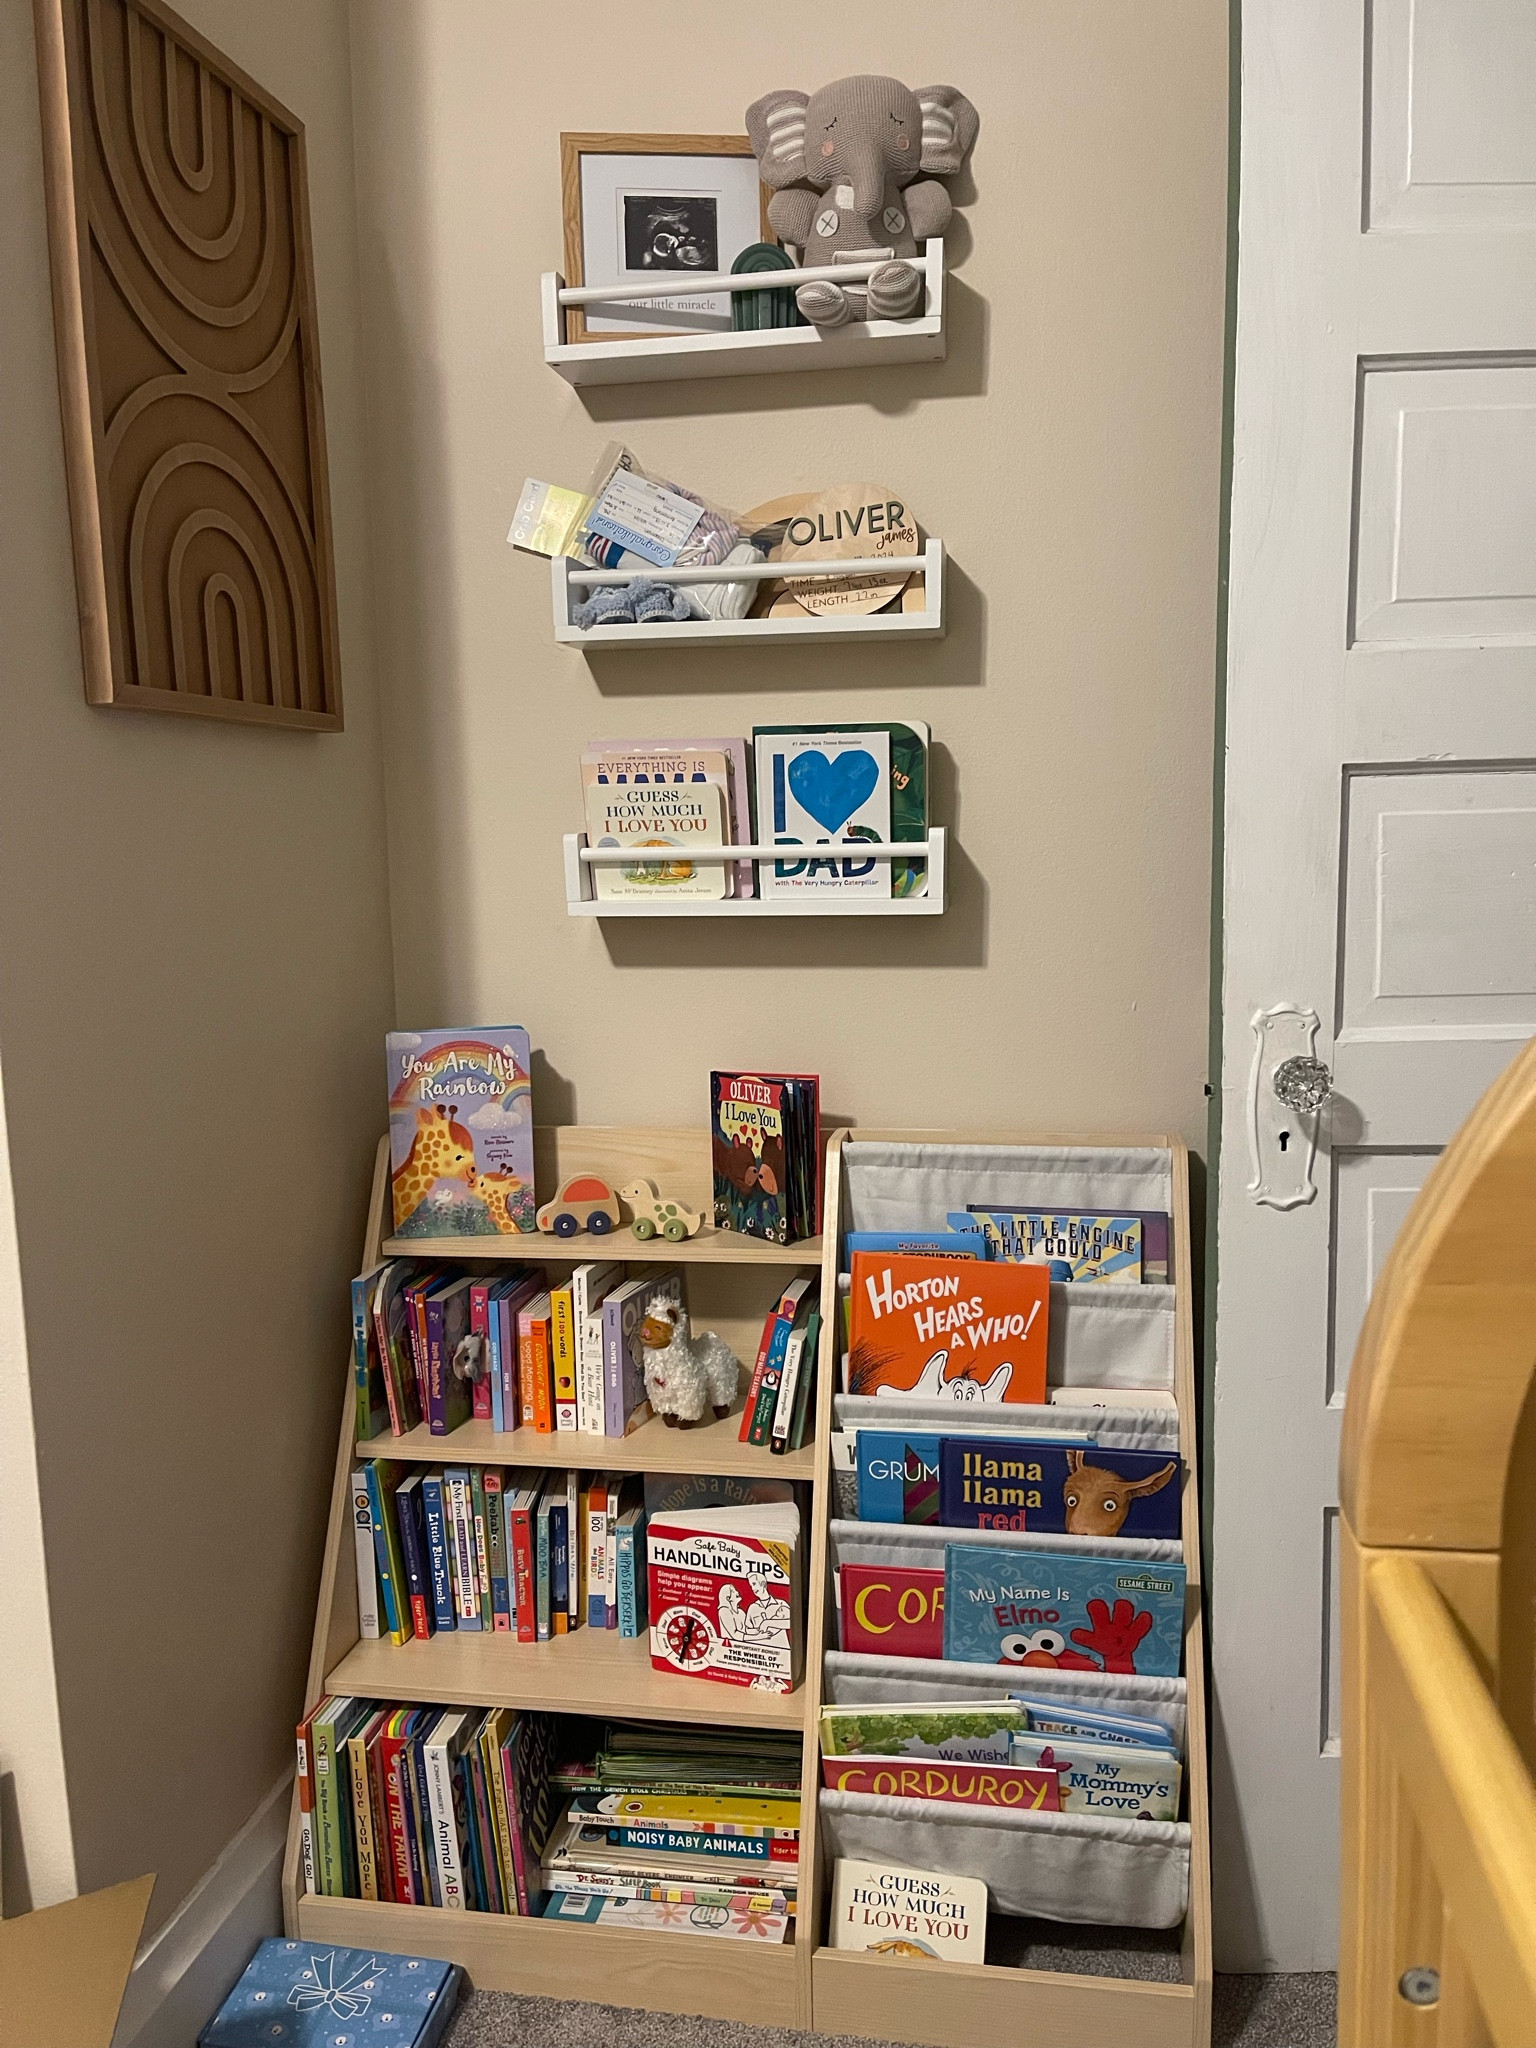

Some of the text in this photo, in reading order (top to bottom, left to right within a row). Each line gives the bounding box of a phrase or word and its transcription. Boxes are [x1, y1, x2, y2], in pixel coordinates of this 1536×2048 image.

[651, 299, 674, 309] little
[677, 299, 715, 309] miracle
[788, 501, 904, 545] OLIVER
[876, 528, 915, 549] james
[790, 577, 815, 586] TIME
[797, 585, 838, 598] WEIGHT
[807, 595, 848, 608] LENGTH
[598, 762, 705, 773] EVERYTHING IS
[627, 791, 679, 803] GUESS
[607, 805, 702, 817] HOW MUCH
[605, 819, 707, 833] I LOVE YOU
[774, 838, 876, 878] DAD
[402, 1052, 516, 1080] You Are My
[418, 1077, 507, 1100] Rainbow
[730, 1082, 771, 1104] OLIVER
[725, 1103, 776, 1128] I Love You
[1000, 1219, 1059, 1239] LITTLE
[1069, 1223, 1136, 1253] ENGINE
[991, 1237, 1102, 1261] THAT COULD
[865, 1268, 960, 1319] HORTON
[558, 1301, 566, 1318] first
[913, 1296, 983, 1342] HEARS
[951, 1300, 1042, 1350] A WHO!
[559, 1336, 567, 1358] words
[535, 1343, 544, 1386] GOODNIGHT
[505, 1383, 509, 1391] ME
[587, 1373, 595, 1407] Bear Hunt
[963, 1453, 1043, 1482] llama
[452, 1487, 461, 1500] My
[660, 1483, 692, 1512] Hope
[963, 1480, 1043, 1509] llama
[354, 1488, 372, 1534] roar
[455, 1501, 463, 1518] First
[977, 1509, 1027, 1532] red
[428, 1512, 440, 1543] Little
[457, 1520, 465, 1540] READ
[591, 1516, 601, 1532] 100
[432, 1546, 443, 1569] Blue
[694, 1539, 741, 1558] Safe Baby
[460, 1553, 468, 1576] LEARN
[654, 1546, 742, 1573] HANDLING
[745, 1560, 785, 1579] TIPS
[435, 1569, 445, 1605] Truck
[657, 1570, 712, 1585] Simple diagrams
[658, 1578, 672, 1586] help
[1118, 1578, 1172, 1592] SESAME STREET
[461, 1579, 472, 1605] BIBLE
[620, 1552, 634, 1628] HIPPOS GO BERSERK!
[969, 1586, 1070, 1605] My Name Is
[992, 1603, 1060, 1628] Elmo
[743, 1652, 766, 1660] WHEEL
[1036, 1721, 1078, 1735] TRACE
[937, 1749, 963, 1762] We
[1094, 1763, 1121, 1779] My
[354, 1768, 364, 1809] Love
[837, 1768, 1049, 1810] CORDUROY
[1068, 1772, 1170, 1800] Mommy's
[435, 1784, 444, 1815] LAMBERT'S
[1084, 1791, 1141, 1810] Love
[358, 1815, 369, 1846] You
[387, 1772, 409, 1878] ON THE FARM
[579, 1814, 669, 1830] Baby Touch Animals
[438, 1820, 454, 1869] Animal
[501, 1835, 508, 1843] to
[627, 1830, 763, 1854] NOISY BABY ANIMALS
[502, 1847, 509, 1856] Go
[360, 1852, 372, 1892] More
[504, 1860, 511, 1869] to
[444, 1874, 460, 1908] ABC
[879, 1874, 941, 1898] GUESS
[853, 1888, 967, 1919] HOW MUCH
[847, 1905, 970, 1941] I LOVE YOU
